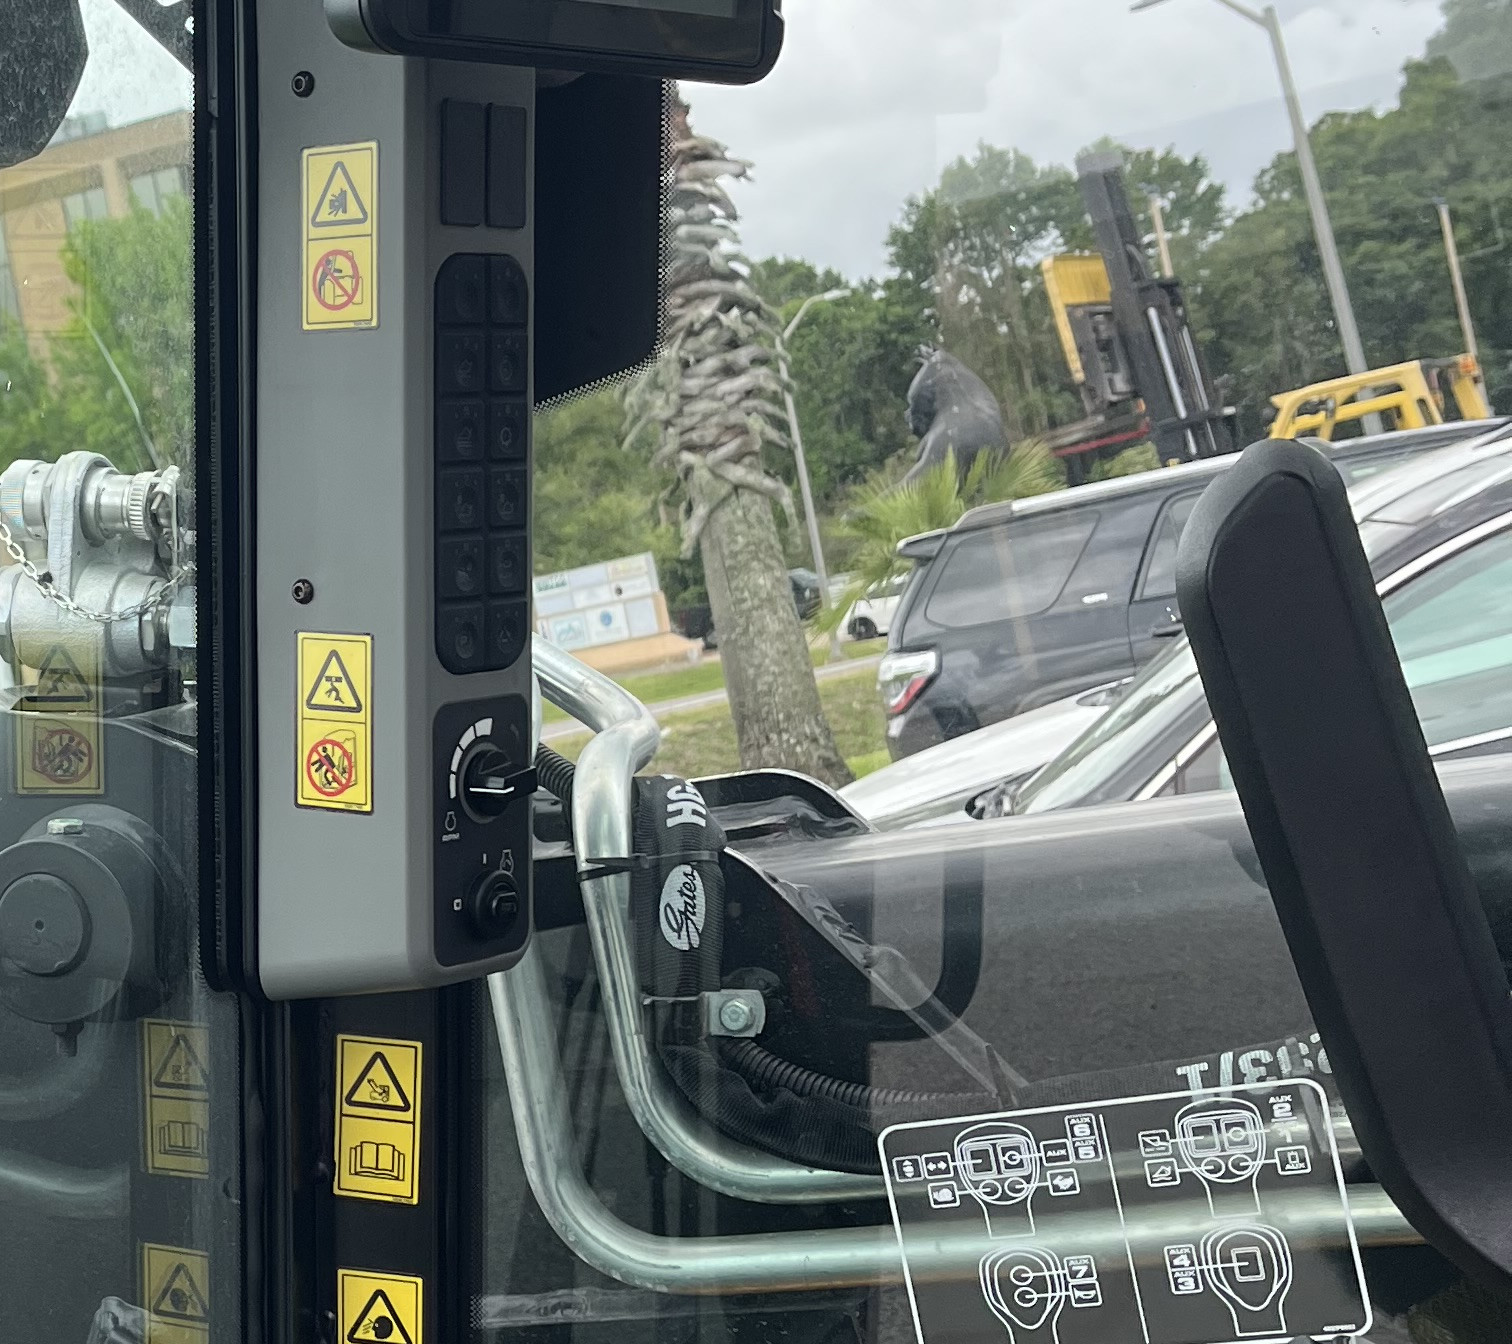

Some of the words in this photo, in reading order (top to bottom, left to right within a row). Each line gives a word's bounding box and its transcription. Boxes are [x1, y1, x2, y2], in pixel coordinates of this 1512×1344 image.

[1272, 1102, 1293, 1118] 2
[1046, 1148, 1067, 1157] AUX
[1173, 1254, 1191, 1267] 4
[1072, 1265, 1089, 1279] 7
[1177, 1277, 1196, 1290] 3
